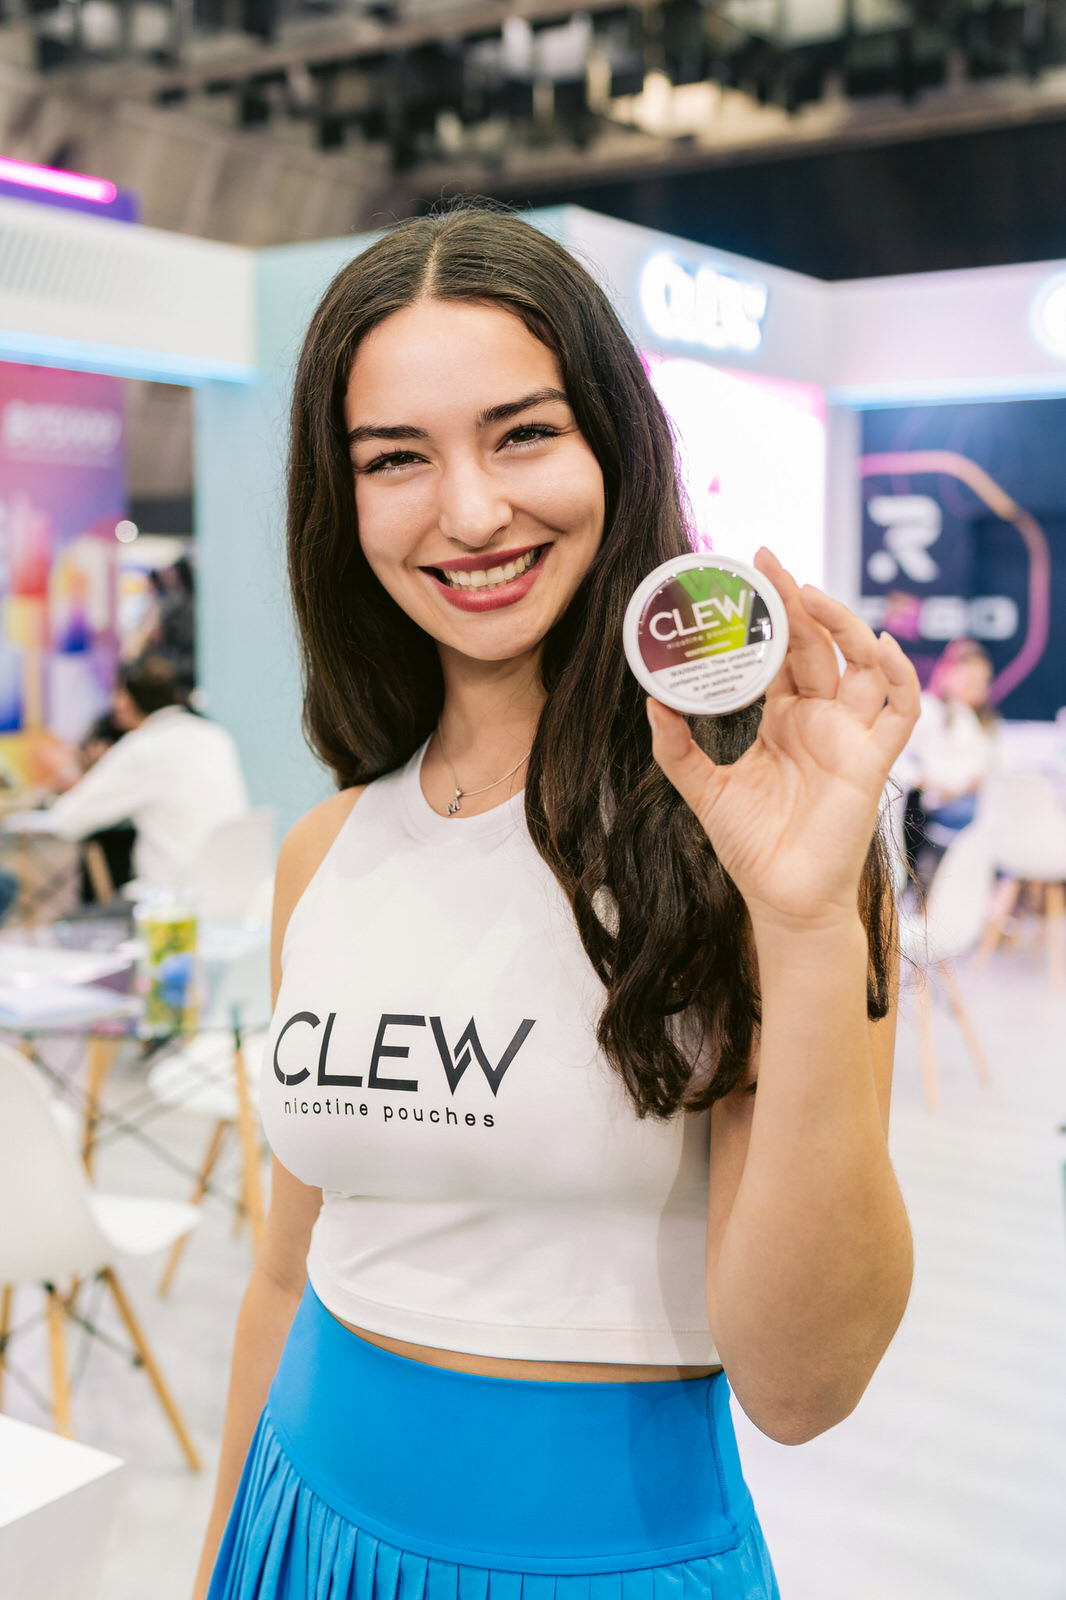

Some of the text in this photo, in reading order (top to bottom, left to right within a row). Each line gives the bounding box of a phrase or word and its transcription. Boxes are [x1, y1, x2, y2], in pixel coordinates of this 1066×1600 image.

[649, 589, 748, 642] CLEW
[666, 634, 704, 650] nicotine
[273, 1011, 537, 1098] CLEW
[284, 1097, 495, 1128] nicotine pouches
